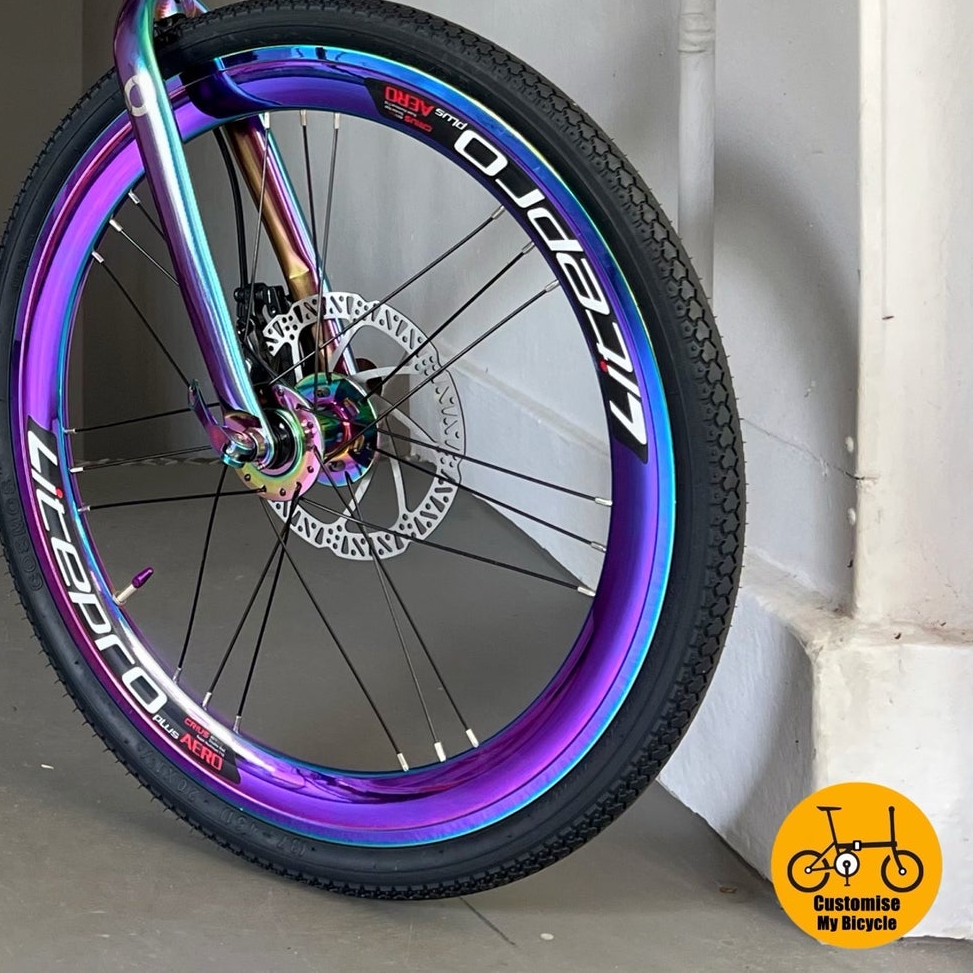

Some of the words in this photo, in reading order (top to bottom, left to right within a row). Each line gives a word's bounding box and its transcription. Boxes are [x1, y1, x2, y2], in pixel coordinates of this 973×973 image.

[384, 85, 435, 117] AERO
[434, 107, 469, 131] plus
[454, 129, 648, 445] Litepro
[27, 429, 168, 714] Litepro
[152, 714, 180, 740] plus
[184, 717, 211, 738] CRIUS
[180, 732, 224, 771] AERO
